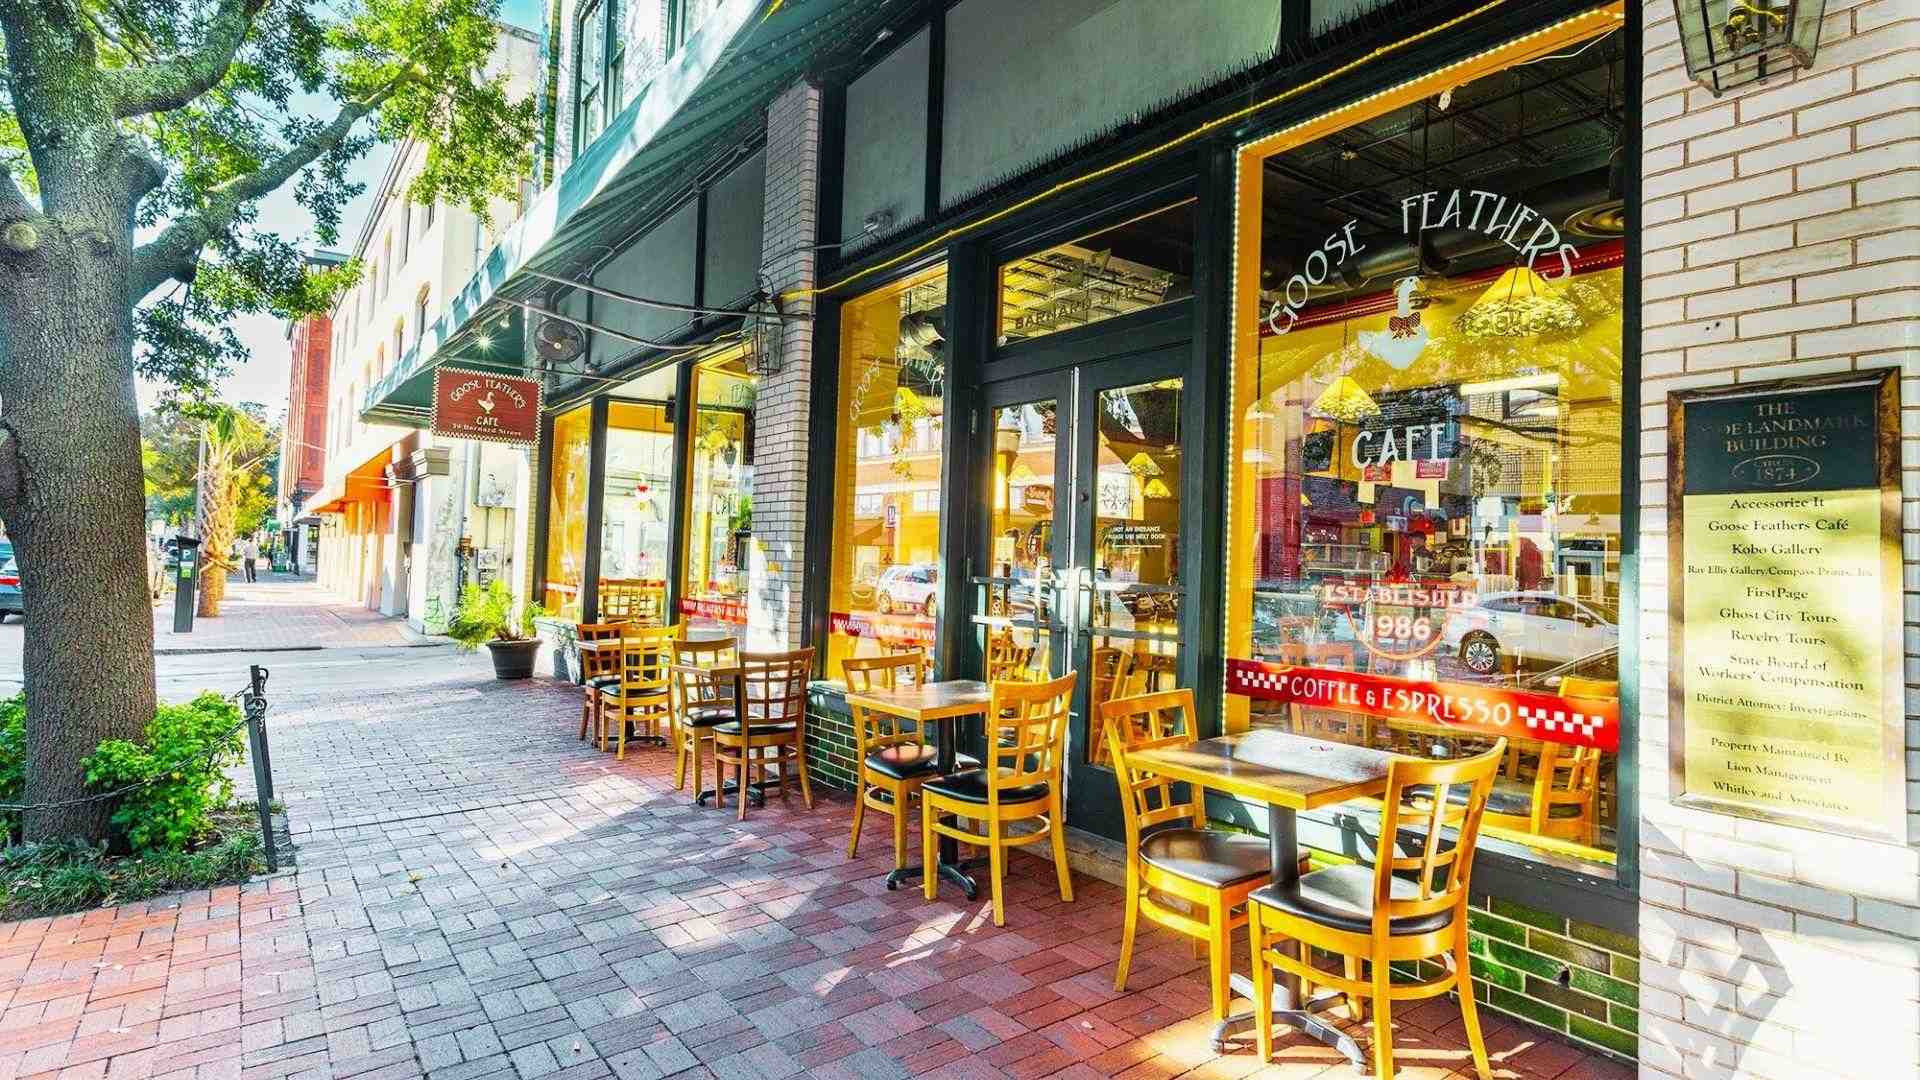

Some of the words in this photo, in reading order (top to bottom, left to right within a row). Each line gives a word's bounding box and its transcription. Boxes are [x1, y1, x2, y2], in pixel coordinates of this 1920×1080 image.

[1268, 219, 1366, 335] GOOSE
[1401, 189, 1580, 281] FEATHERS
[450, 379, 482, 401] GOOSE
[485, 379, 527, 408] FEATHERS
[1754, 402, 1796, 417] THE
[476, 416, 499, 427] CAFE
[1748, 414, 1867, 435] LANDMARK
[1352, 423, 1447, 469] CAFE
[1726, 435, 1827, 453] BUILDING
[1730, 498, 1809, 510] Accessorize
[1811, 496, 1824, 508] It
[1708, 521, 1750, 531] Goose
[1753, 519, 1811, 531] Feathers
[1815, 517, 1849, 531] Café
[183, 549, 191, 559] P
[1731, 543, 1768, 555] Kobo
[1771, 543, 1822, 556] Gallery
[1687, 565, 1705, 575] Ray
[1708, 565, 1728, 575] Ellis
[1325, 584, 1479, 608] ESTABLISHED
[1746, 586, 1809, 600] FirstPage
[1719, 607, 1760, 621] Ghost
[1763, 609, 1793, 622] City
[1799, 610, 1839, 624] Tours
[1366, 614, 1431, 641] 1986
[1730, 630, 1782, 644] Revelry
[1788, 632, 1827, 646] Tours
[1730, 654, 1762, 667] State
[1767, 656, 1809, 671] Board
[1812, 659, 1829, 671] of
[1760, 670, 1864, 692] Compensation
[1291, 676, 1361, 705] COFFEE
[1365, 689, 1376, 707] &
[1382, 687, 1511, 729] ESPRESSO
[1696, 692, 1734, 706] District
[1789, 702, 1868, 720] Investigations
[1711, 736, 1758, 753] Property
[1762, 742, 1830, 762] Maintained
[1834, 751, 1850, 765] By
[1726, 760, 1752, 774] Lion
[1755, 765, 1832, 785] Management
[1712, 780, 1757, 798] Whitley
[1760, 789, 1782, 801] and
